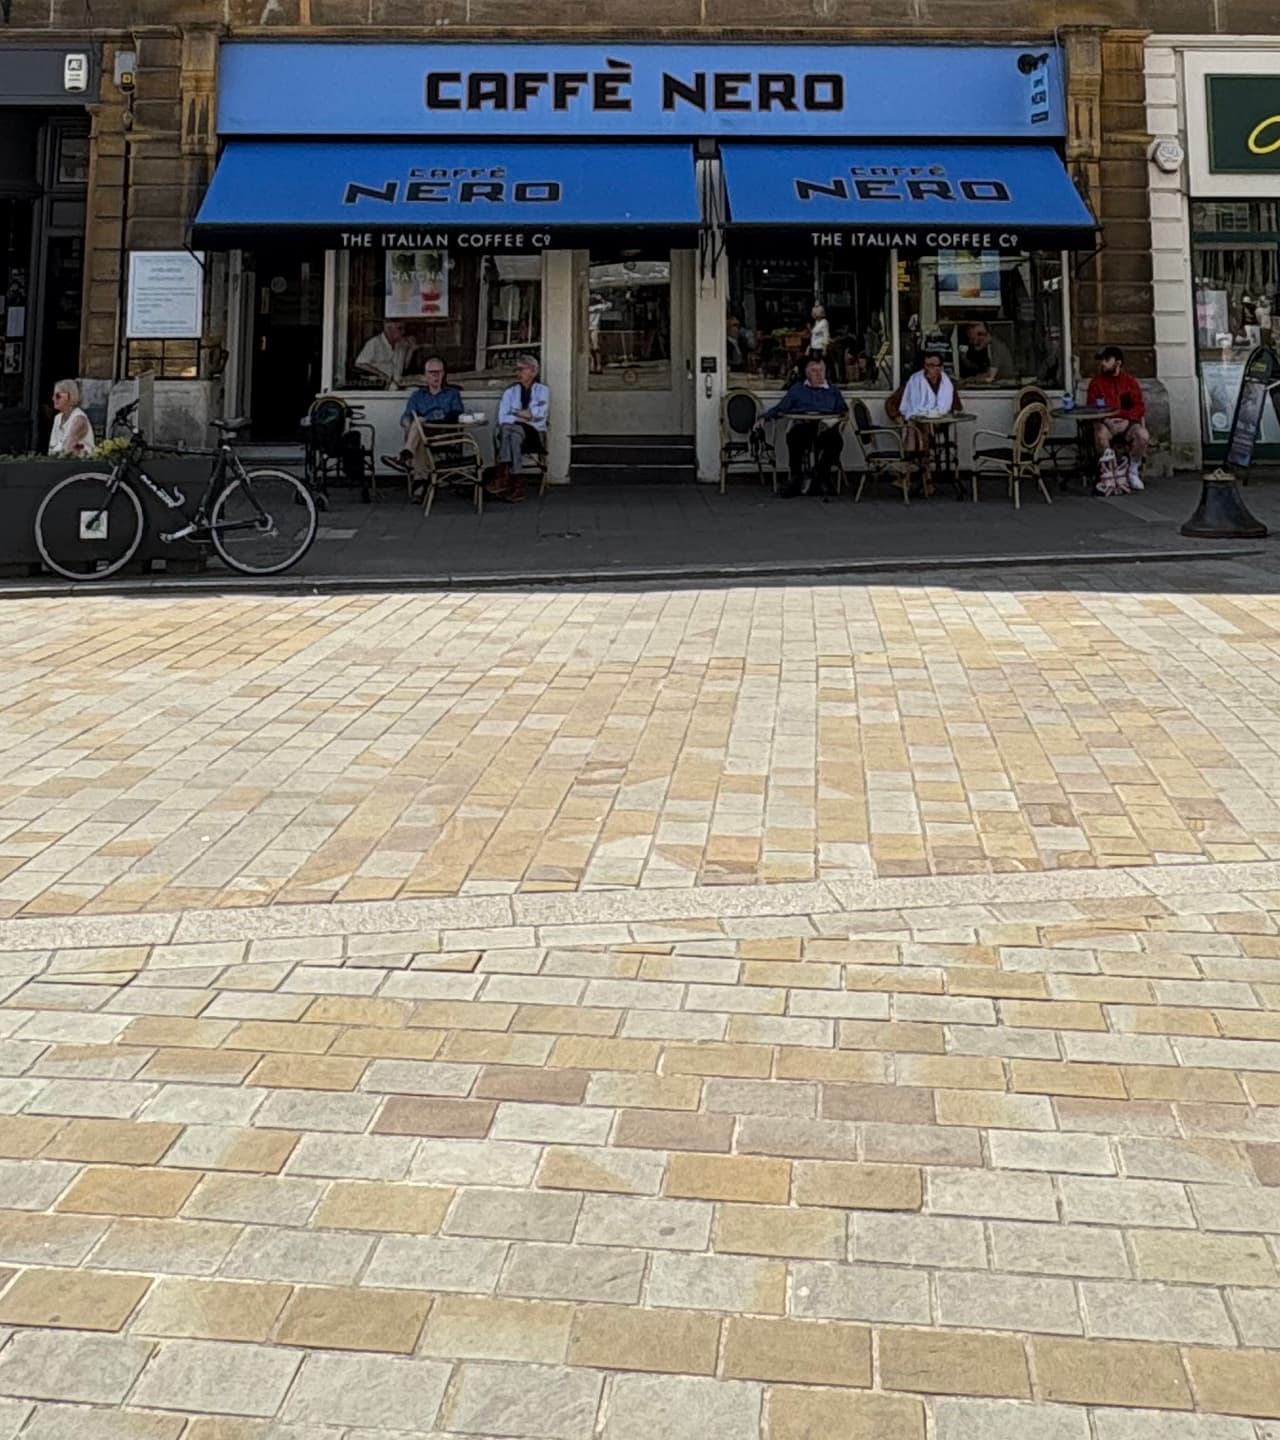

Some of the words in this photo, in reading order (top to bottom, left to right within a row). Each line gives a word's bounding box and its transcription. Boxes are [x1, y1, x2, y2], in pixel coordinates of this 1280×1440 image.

[425, 57, 633, 112] CAFFÈ
[661, 71, 845, 113] NERO
[344, 180, 562, 205] NERO
[793, 178, 1012, 202] NERO
[341, 233, 372, 247] THE
[381, 233, 449, 247] ITALIAN
[457, 233, 524, 248] COFFEE
[811, 232, 842, 247] THE
[851, 232, 917, 247] ITALIAN
[926, 232, 991, 247] COFFEE
